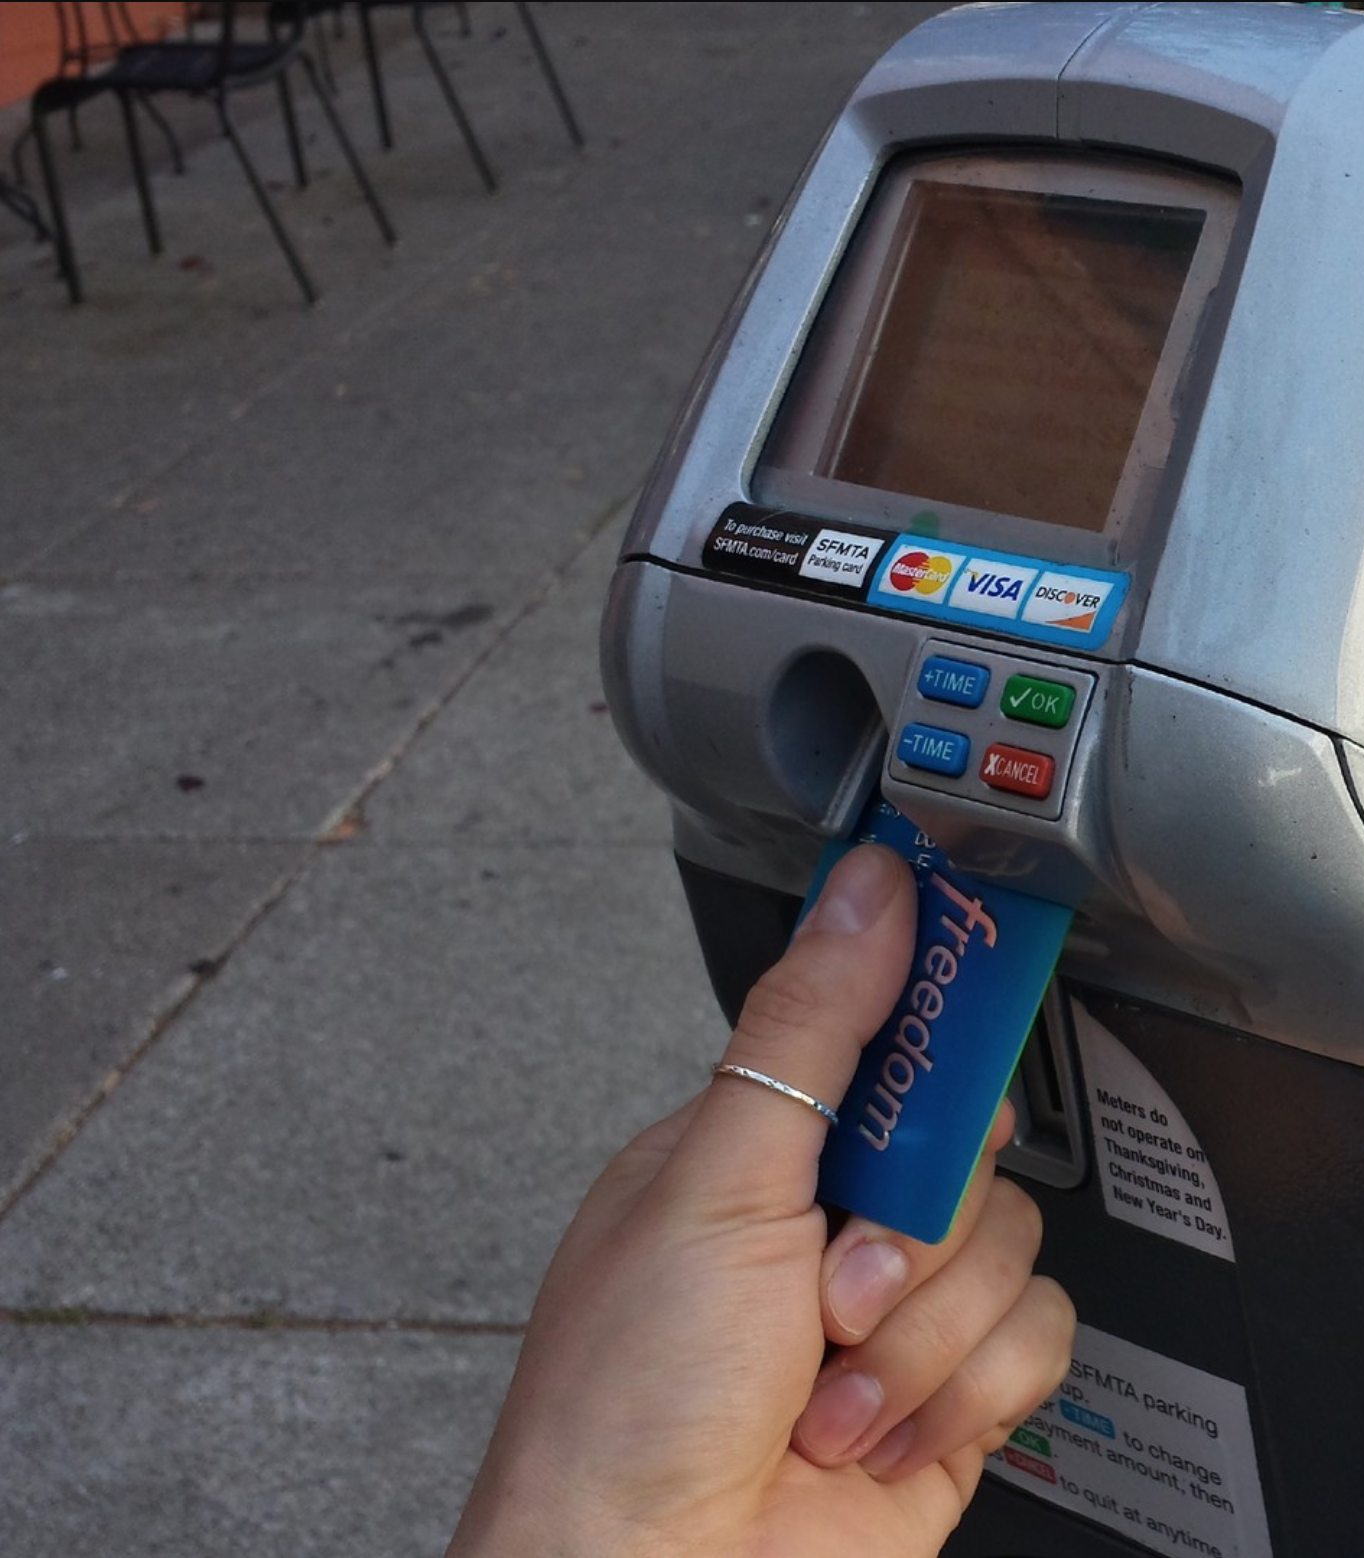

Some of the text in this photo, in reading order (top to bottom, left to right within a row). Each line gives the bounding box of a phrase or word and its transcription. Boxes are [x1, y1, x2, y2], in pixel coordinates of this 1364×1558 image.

[713, 536, 799, 565] SFMTA.com/card
[724, 518, 809, 547] To purchase visit
[816, 538, 870, 560] SFMTA
[807, 554, 863, 574] Parking card
[893, 562, 949, 583] MasterCard
[966, 572, 1023, 601] VISA
[1034, 586, 1100, 609] DISCOVER
[858, 870, 997, 1152] freedom
[1096, 1088, 1169, 1127] Meters do
[1101, 1115, 1206, 1163] not operate on
[1104, 1136, 1206, 1190] Thanksgiving,
[1109, 1161, 1213, 1212] Christmas and
[1112, 1185, 1228, 1241] New Year's Day.
[1069, 1359, 1219, 1438] SFMTA parking
[1107, 1447, 1187, 1494] amount,
[1190, 1482, 1235, 1515] then
[1123, 1430, 1145, 1452] to
[1148, 1443, 1223, 1486] change
[1060, 1475, 1080, 1496] to
[1083, 1488, 1120, 1516] quit
[1123, 1506, 1143, 1524] at
